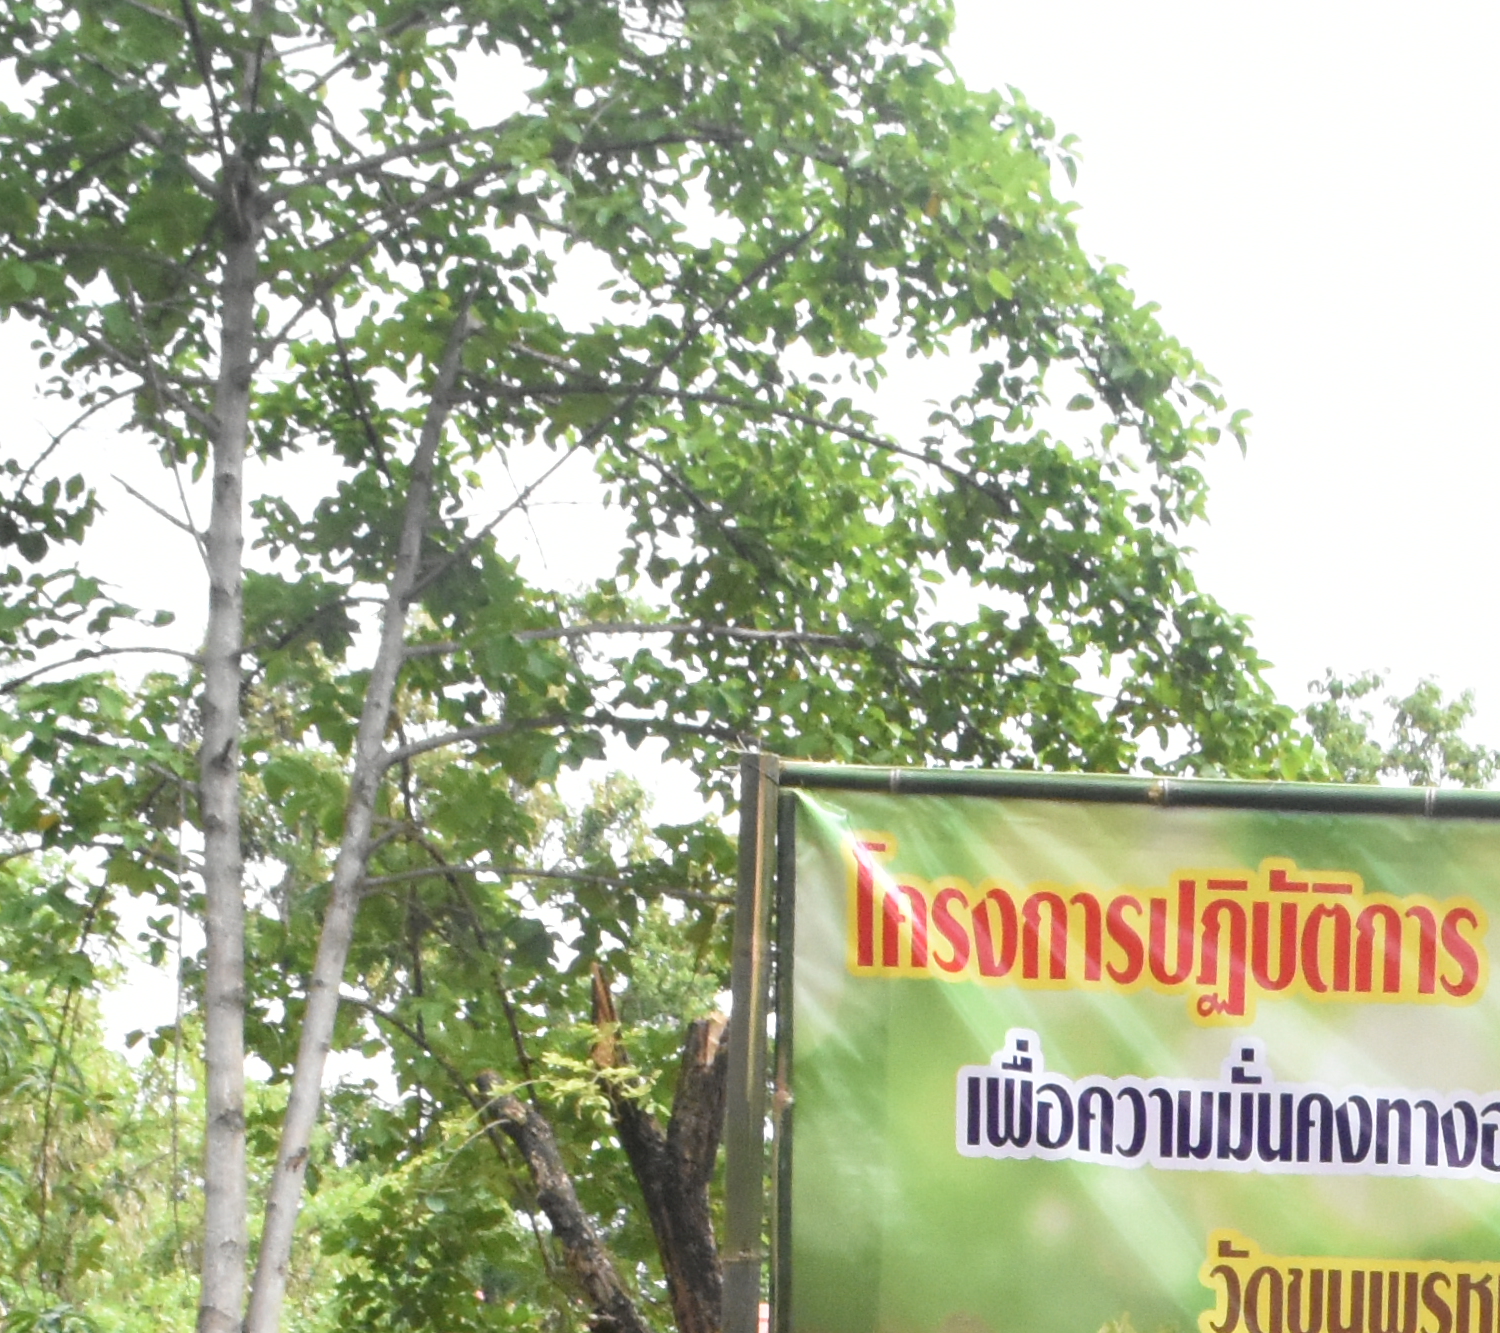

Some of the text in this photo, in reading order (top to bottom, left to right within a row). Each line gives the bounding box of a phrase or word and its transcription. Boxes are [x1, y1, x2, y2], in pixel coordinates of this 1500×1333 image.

[852, 843, 1481, 1017] โครงการปฏิบัติการ
